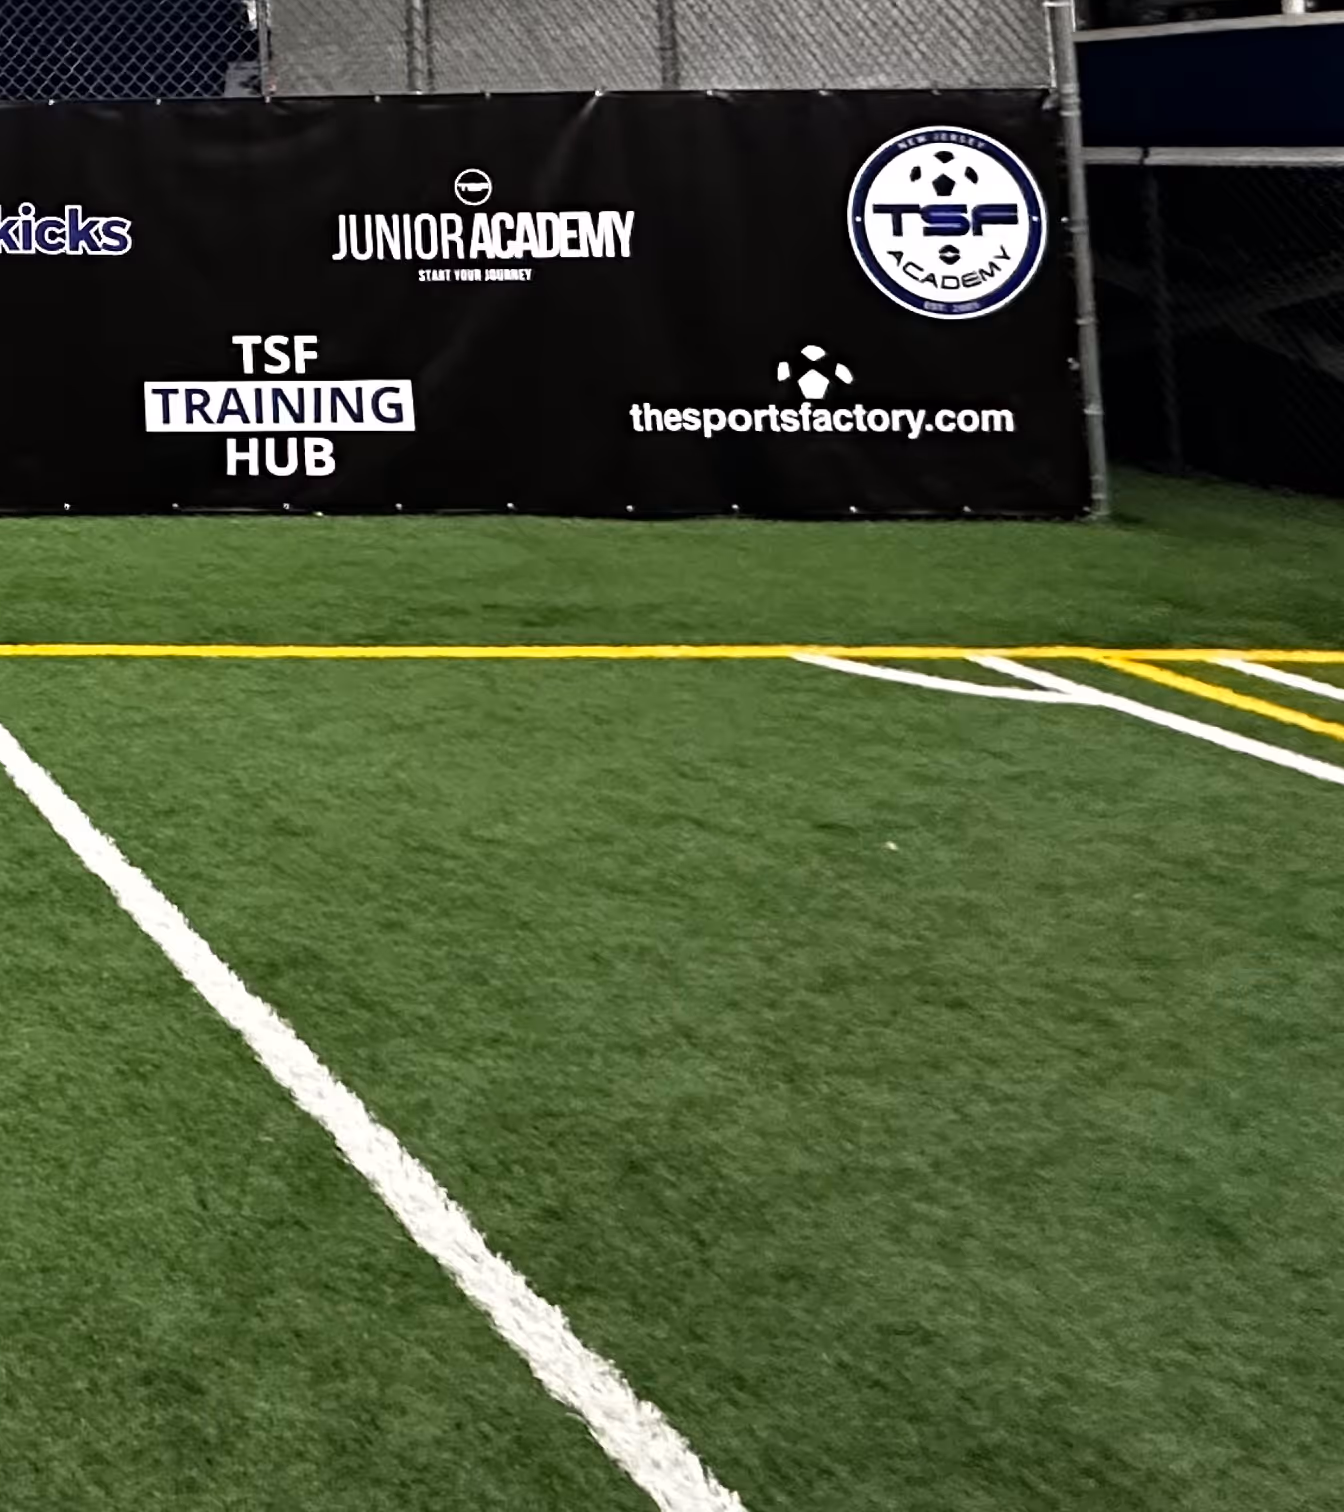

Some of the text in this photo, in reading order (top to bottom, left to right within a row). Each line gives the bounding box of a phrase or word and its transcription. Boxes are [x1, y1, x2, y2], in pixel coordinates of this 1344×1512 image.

[331, 210, 635, 260] JUNIOR ACADEMY
[872, 203, 1019, 237] TSF
[886, 244, 1011, 290] ACADEMY
[231, 334, 319, 375] TSF
[151, 386, 405, 425] TRAINING
[629, 402, 1015, 440] thesportsfactory.com
[225, 436, 337, 477] HUB
